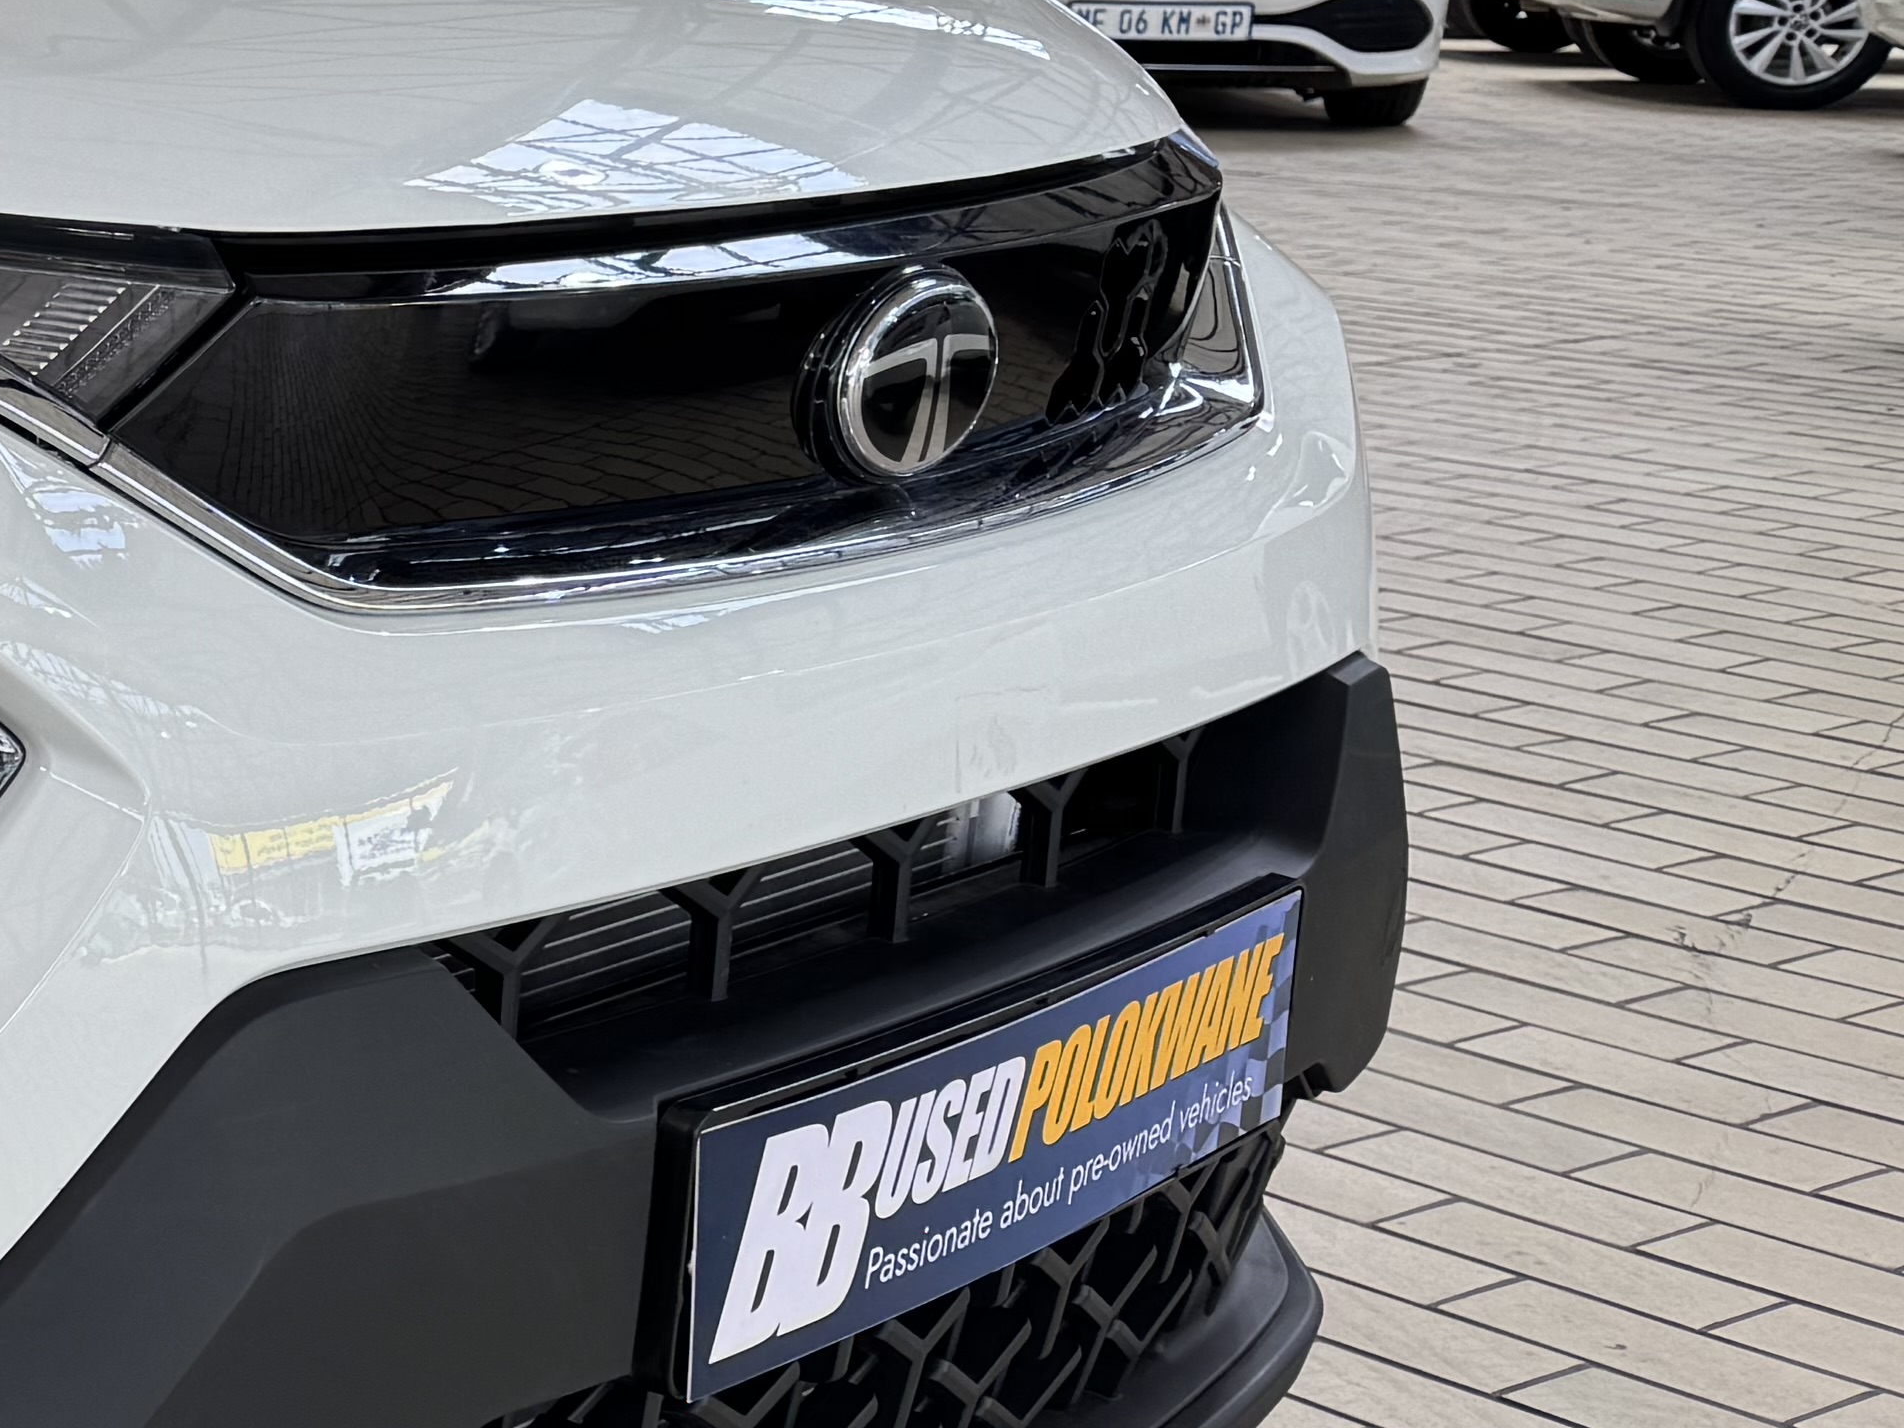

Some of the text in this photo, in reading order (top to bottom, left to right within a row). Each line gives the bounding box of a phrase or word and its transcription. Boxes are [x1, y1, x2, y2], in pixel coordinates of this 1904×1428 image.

[1119, 9, 1148, 35] 06
[1160, 9, 1192, 35] KM
[1214, 10, 1244, 36] GP
[864, 1070, 1254, 1290] Passionate about pre-owned vehicles
